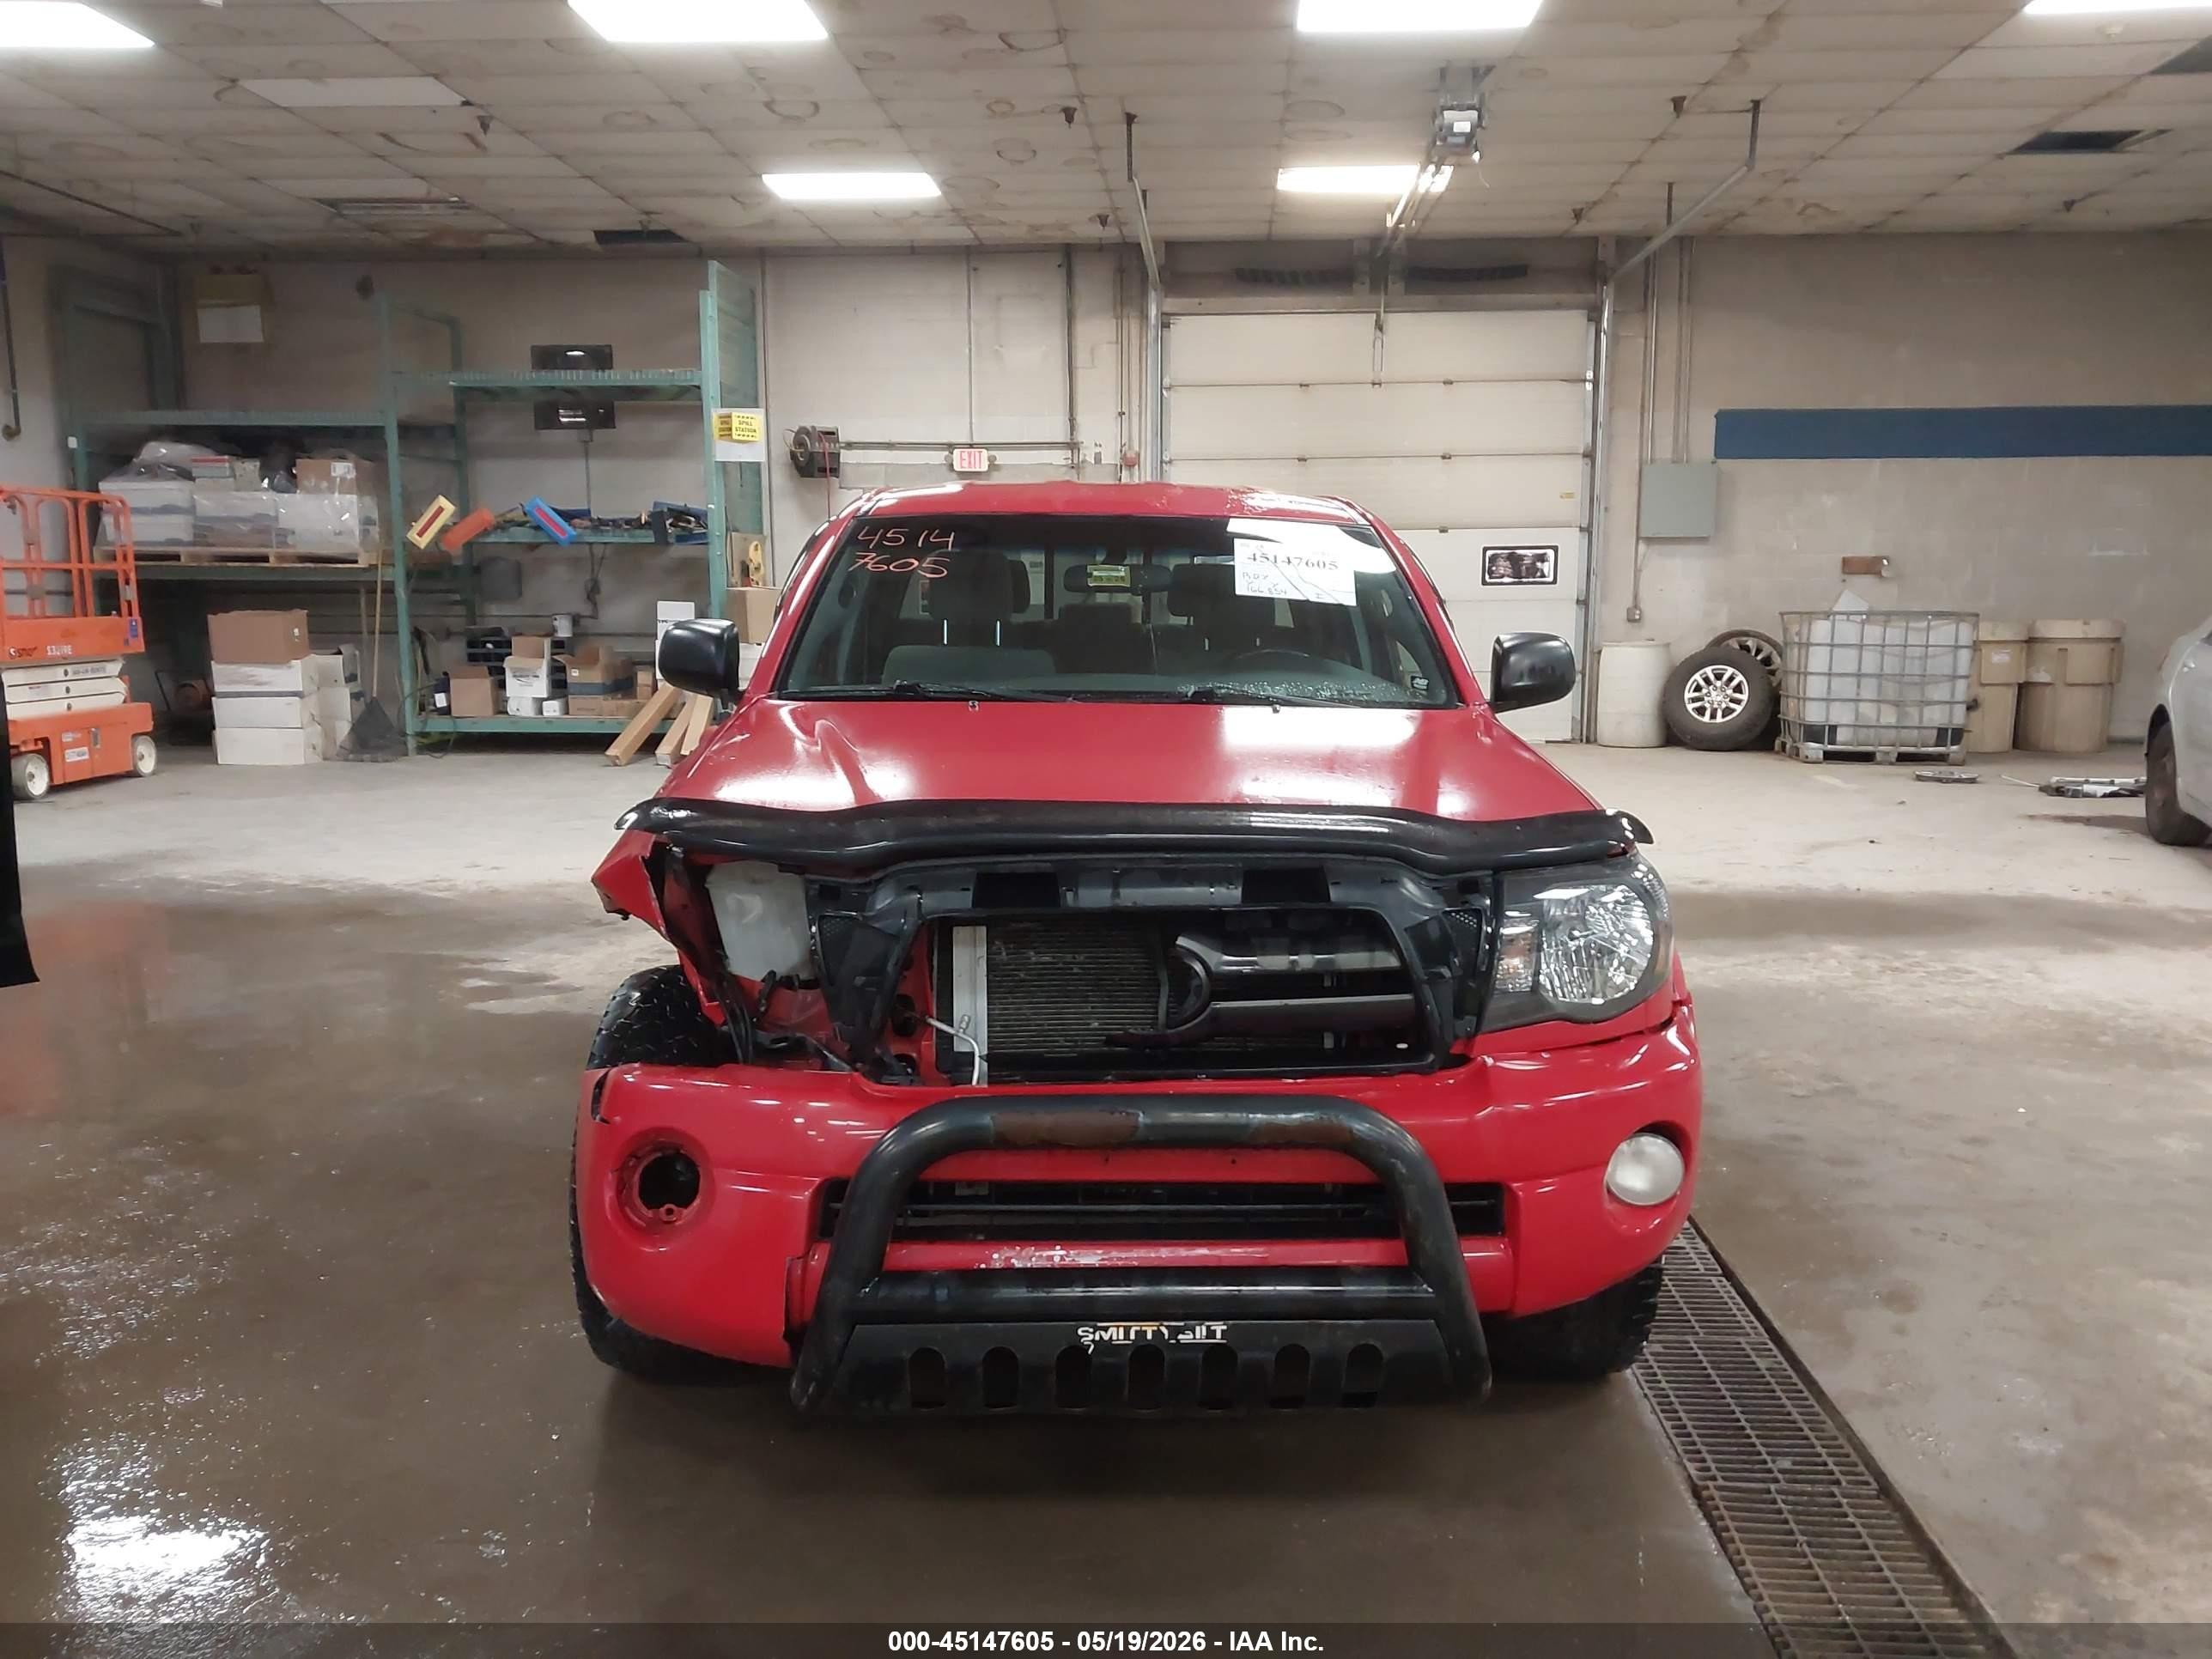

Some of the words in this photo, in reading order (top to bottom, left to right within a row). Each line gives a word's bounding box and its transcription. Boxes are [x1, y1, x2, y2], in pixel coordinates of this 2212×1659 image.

[959, 450, 983, 469] EXIT
[848, 552, 951, 578] 7605
[1247, 552, 1339, 570] 45147605
